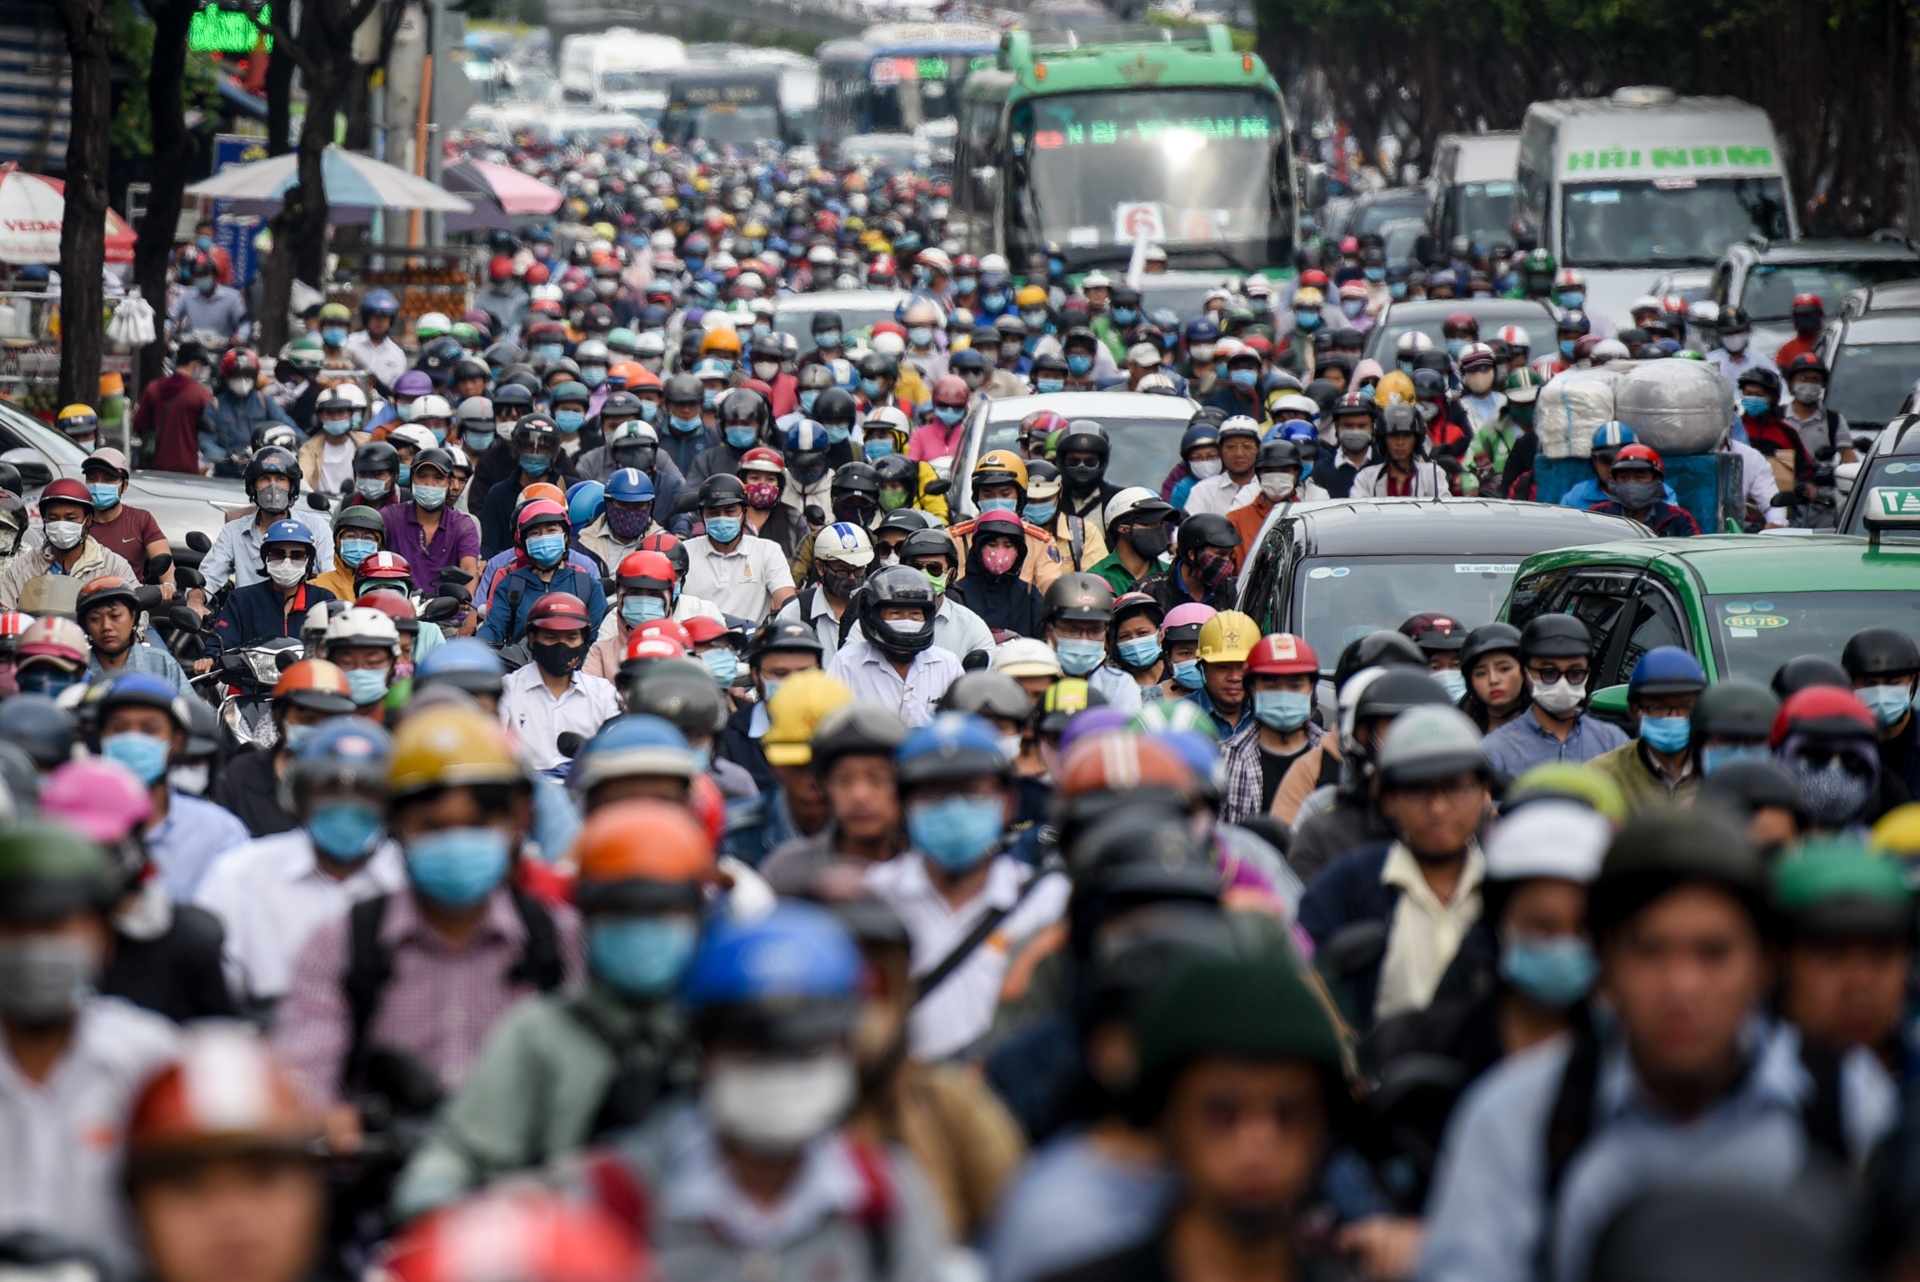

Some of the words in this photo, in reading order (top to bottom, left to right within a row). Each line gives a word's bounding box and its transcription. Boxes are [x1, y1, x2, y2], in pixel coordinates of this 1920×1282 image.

[1651, 145, 1773, 168] NAM
[4, 219, 62, 232] VEDA
[1125, 206, 1155, 239] 6
